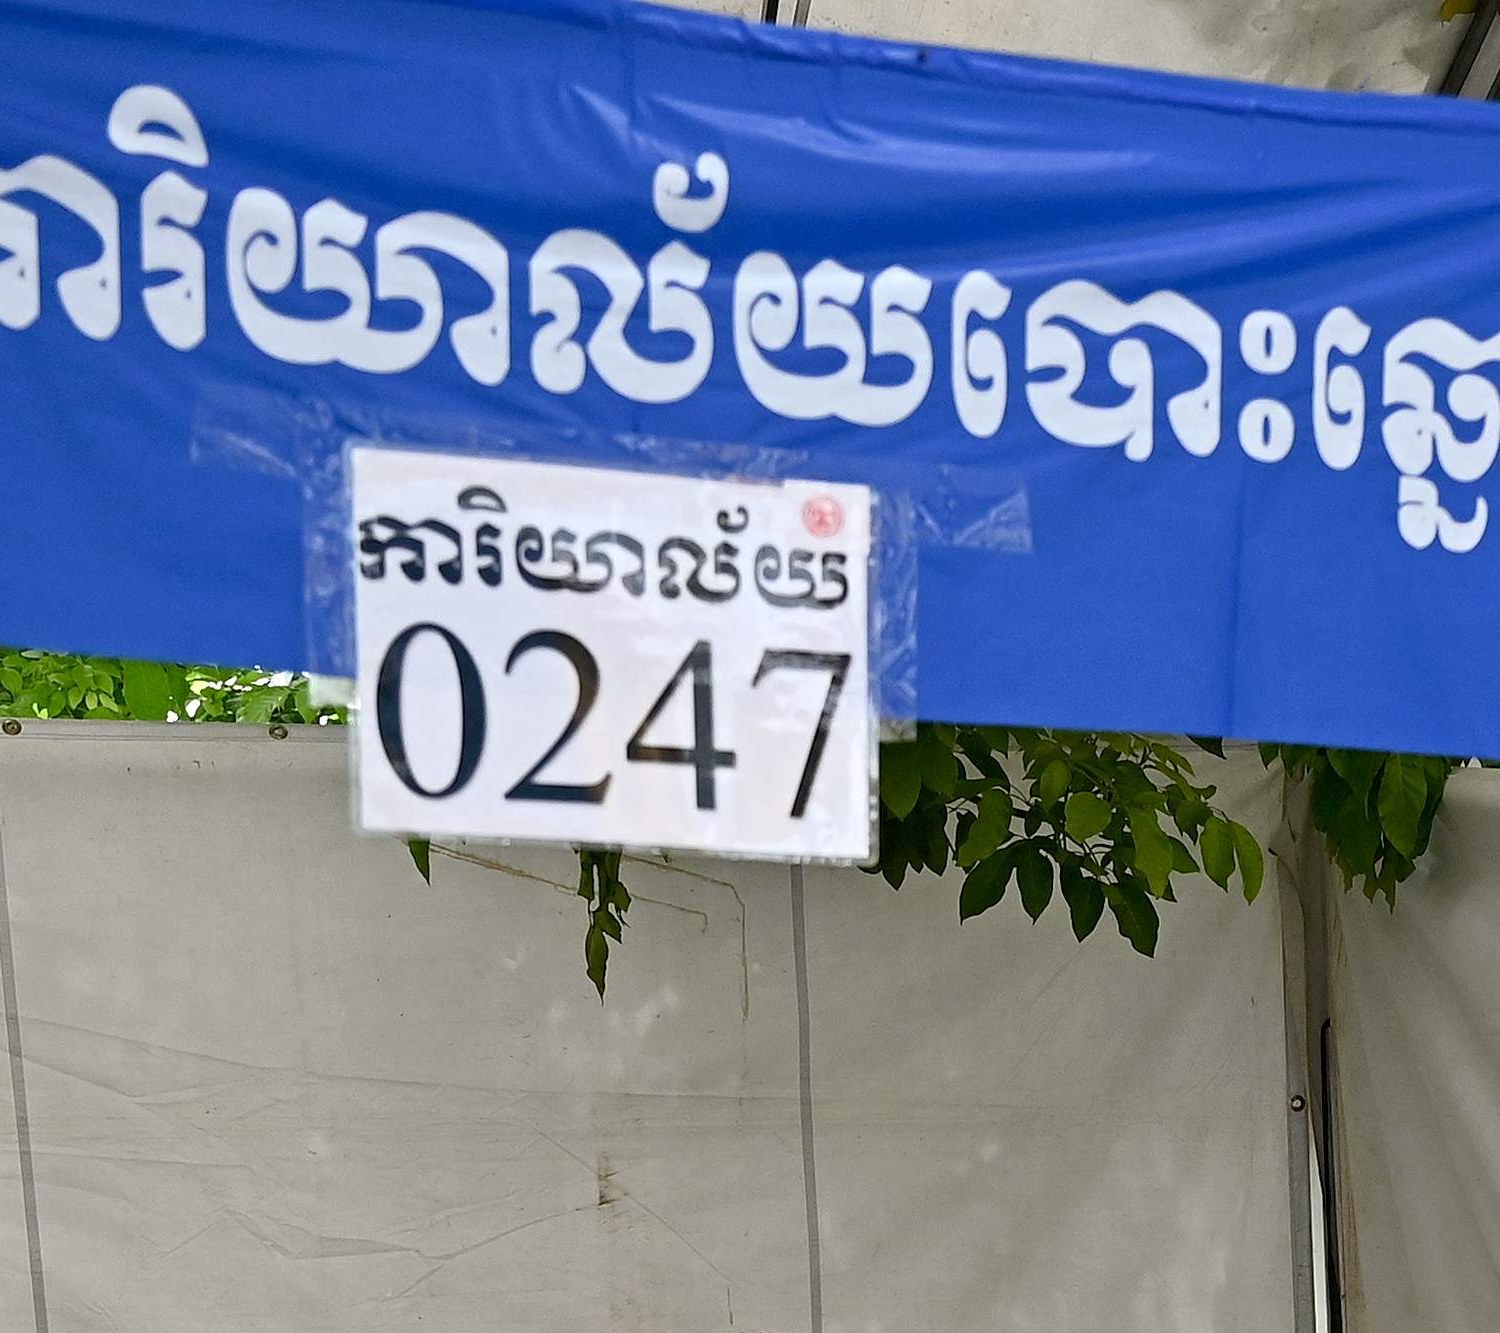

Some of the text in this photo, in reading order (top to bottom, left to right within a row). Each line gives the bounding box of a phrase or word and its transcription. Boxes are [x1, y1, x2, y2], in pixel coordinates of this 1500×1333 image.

[358, 486, 849, 610] ការិយាល័យ
[376, 622, 852, 818] 0247
